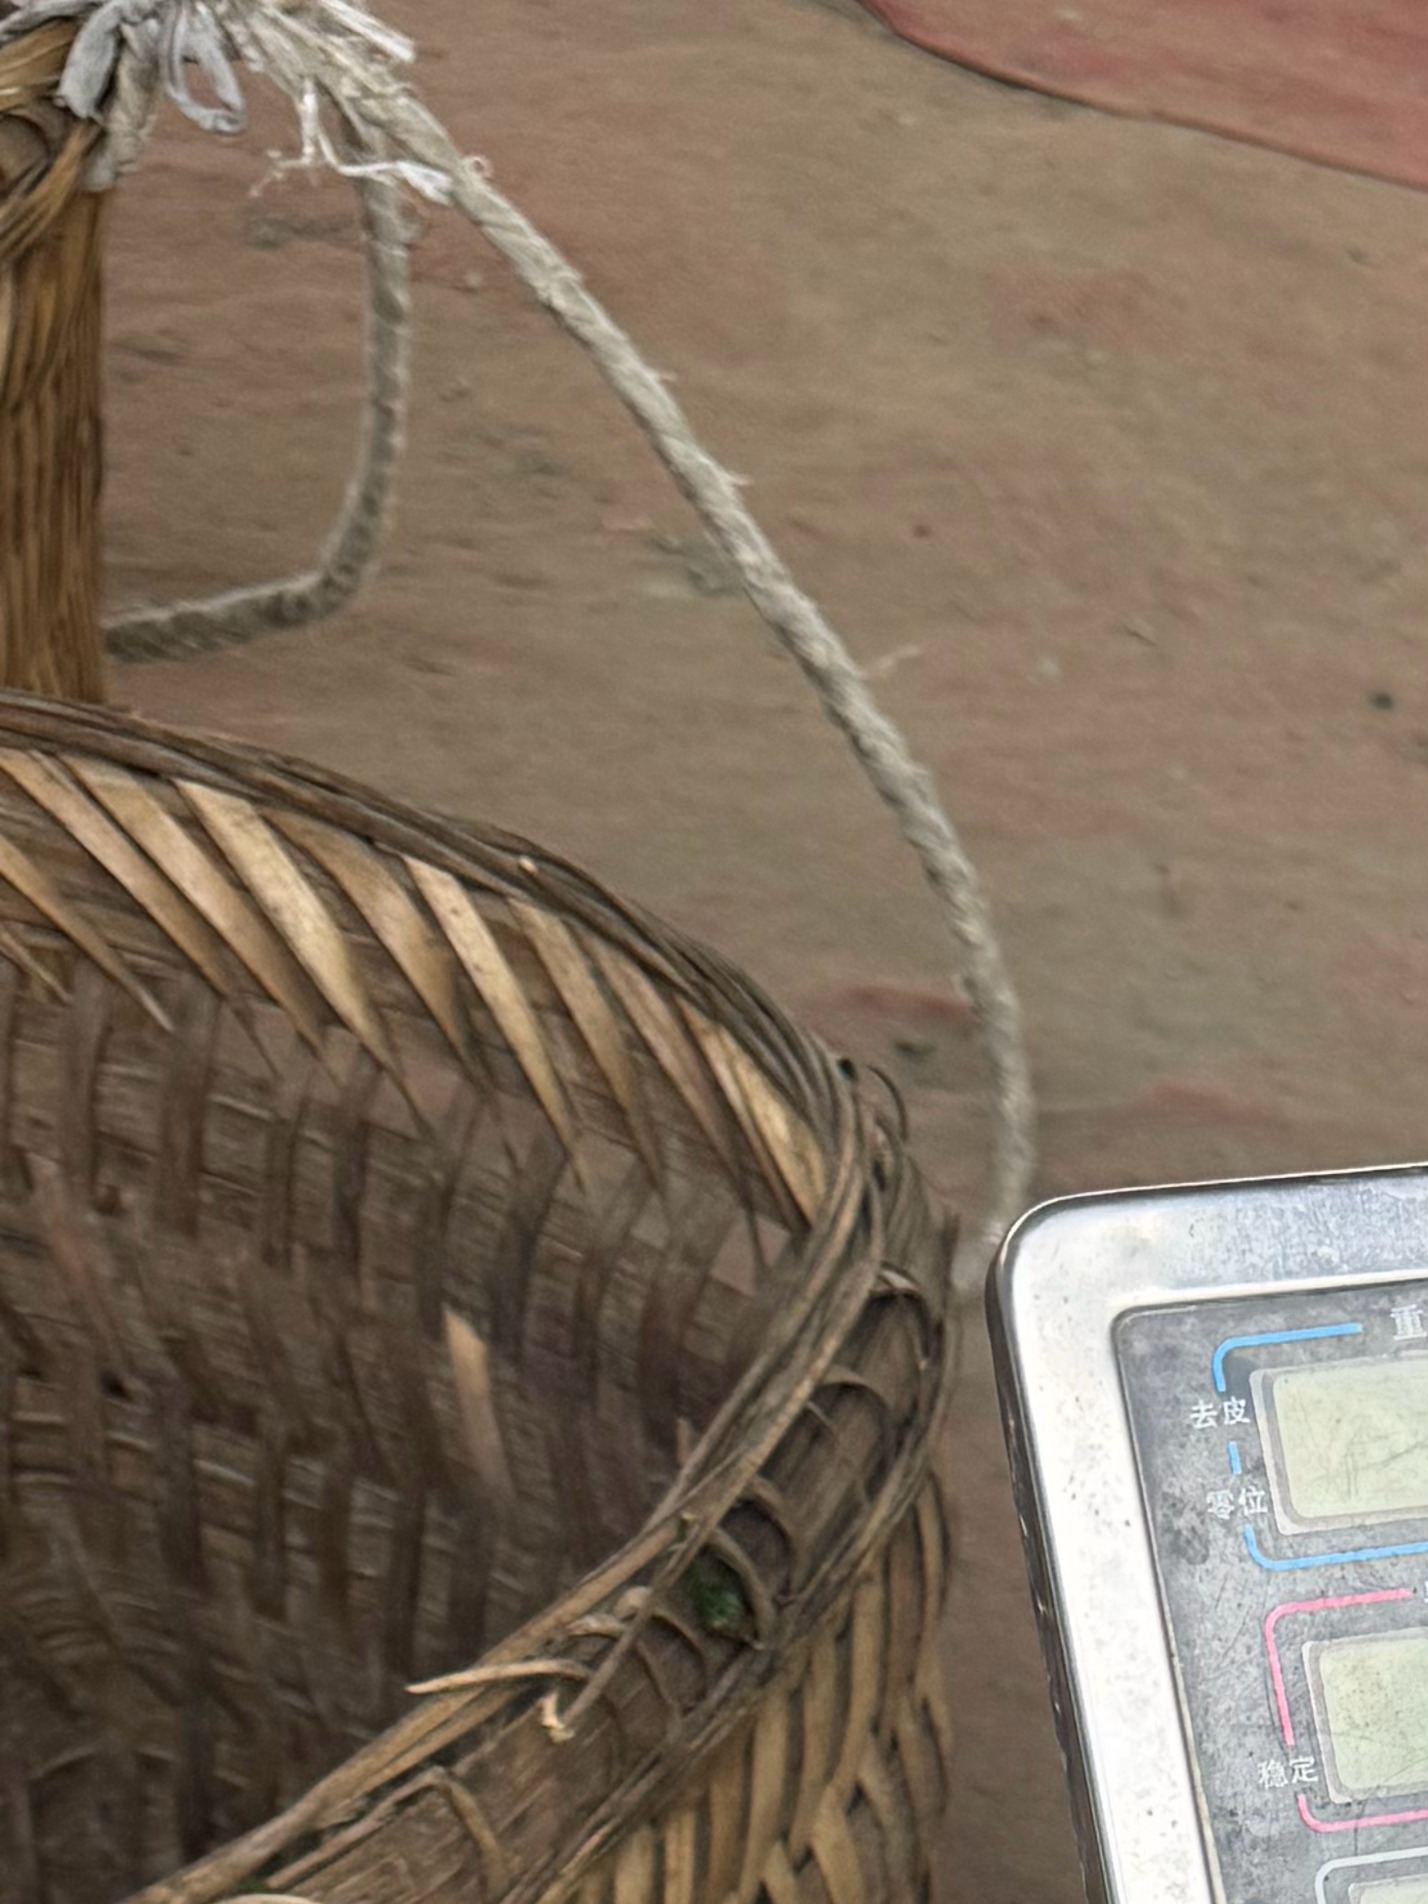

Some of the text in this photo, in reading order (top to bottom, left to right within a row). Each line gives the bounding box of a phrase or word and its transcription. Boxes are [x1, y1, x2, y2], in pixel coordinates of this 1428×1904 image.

[1189, 1395, 1251, 1430] 去皮
[1205, 1485, 1269, 1520] 零位
[1257, 1754, 1319, 1789] 稳定
